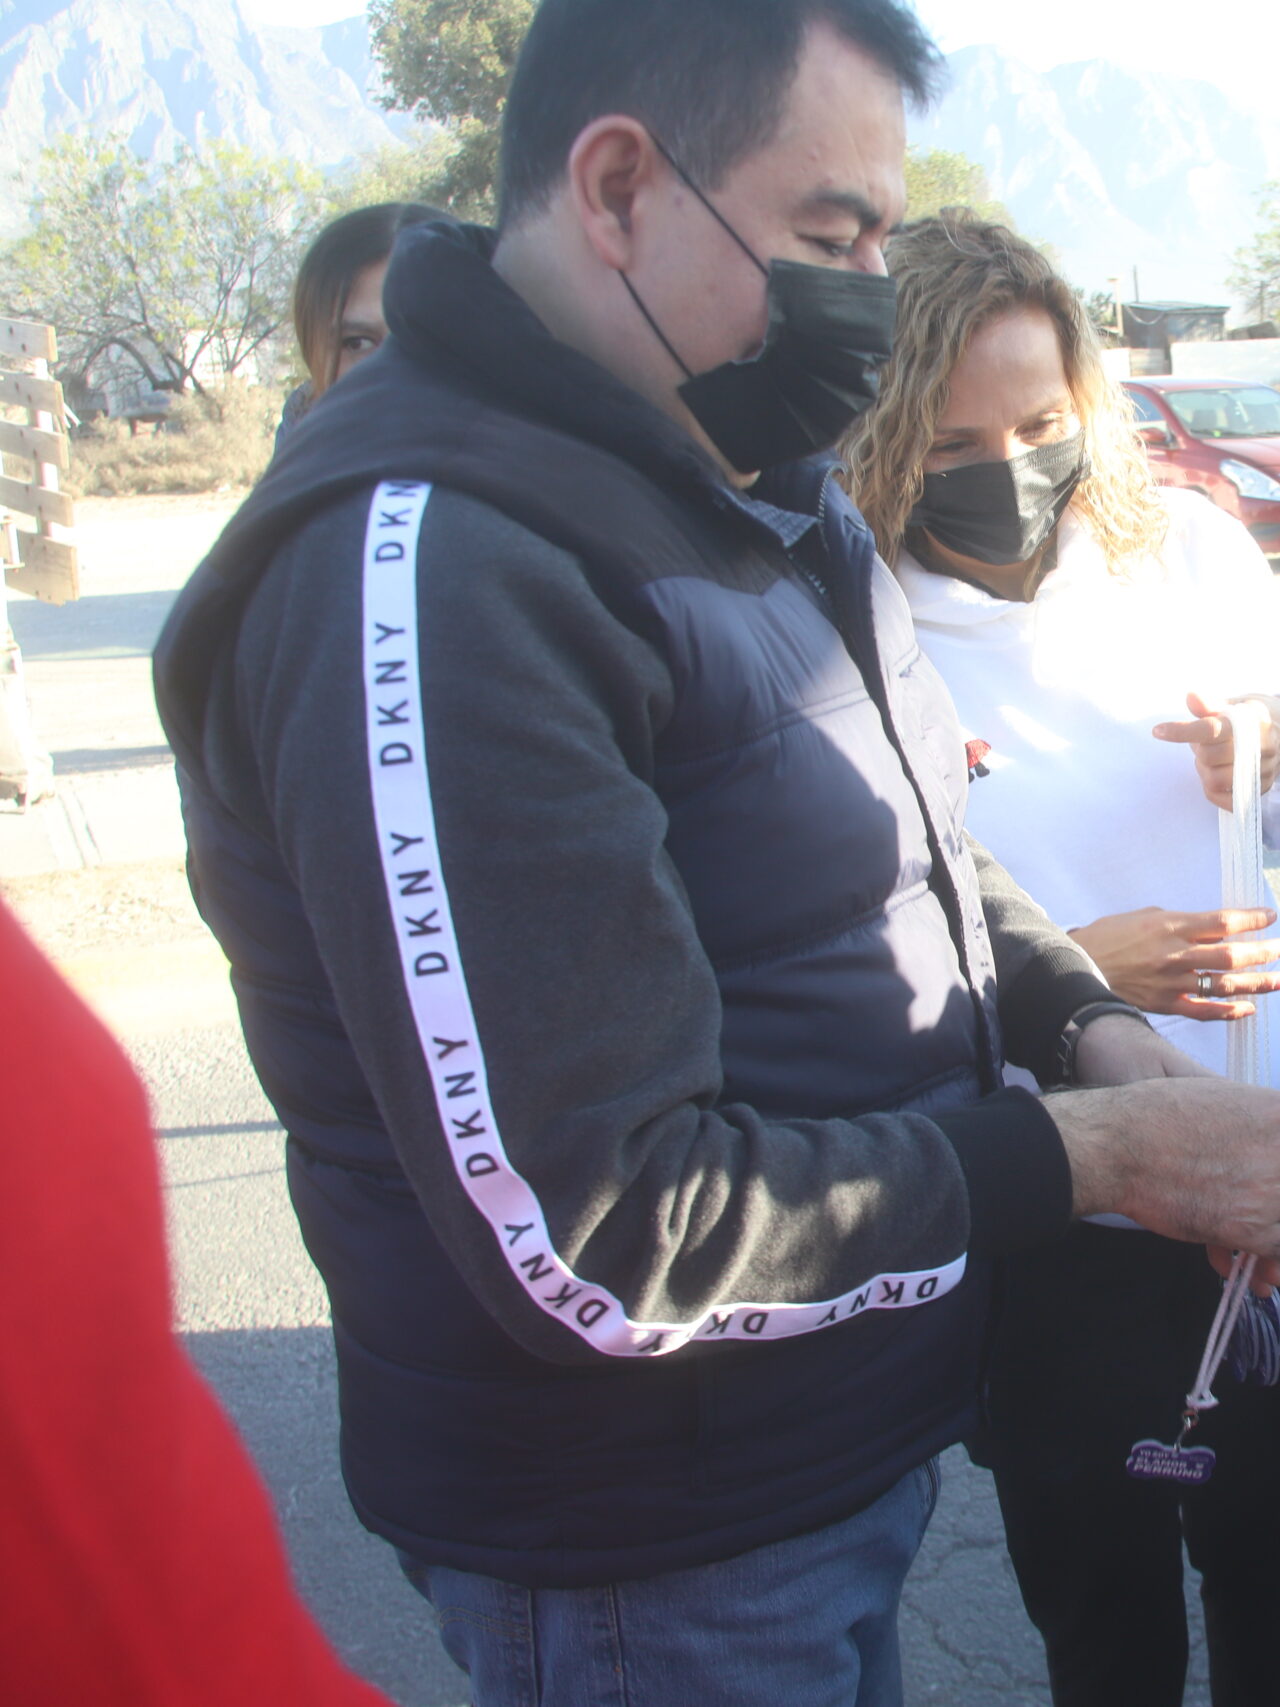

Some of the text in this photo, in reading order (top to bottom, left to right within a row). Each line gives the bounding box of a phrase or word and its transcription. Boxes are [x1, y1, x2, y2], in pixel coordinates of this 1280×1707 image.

[375, 480, 939, 1352] DKNY DKY DKNY DKNY DKNY DKNY DKN
[1133, 1463, 1203, 1478] PERRUNO
